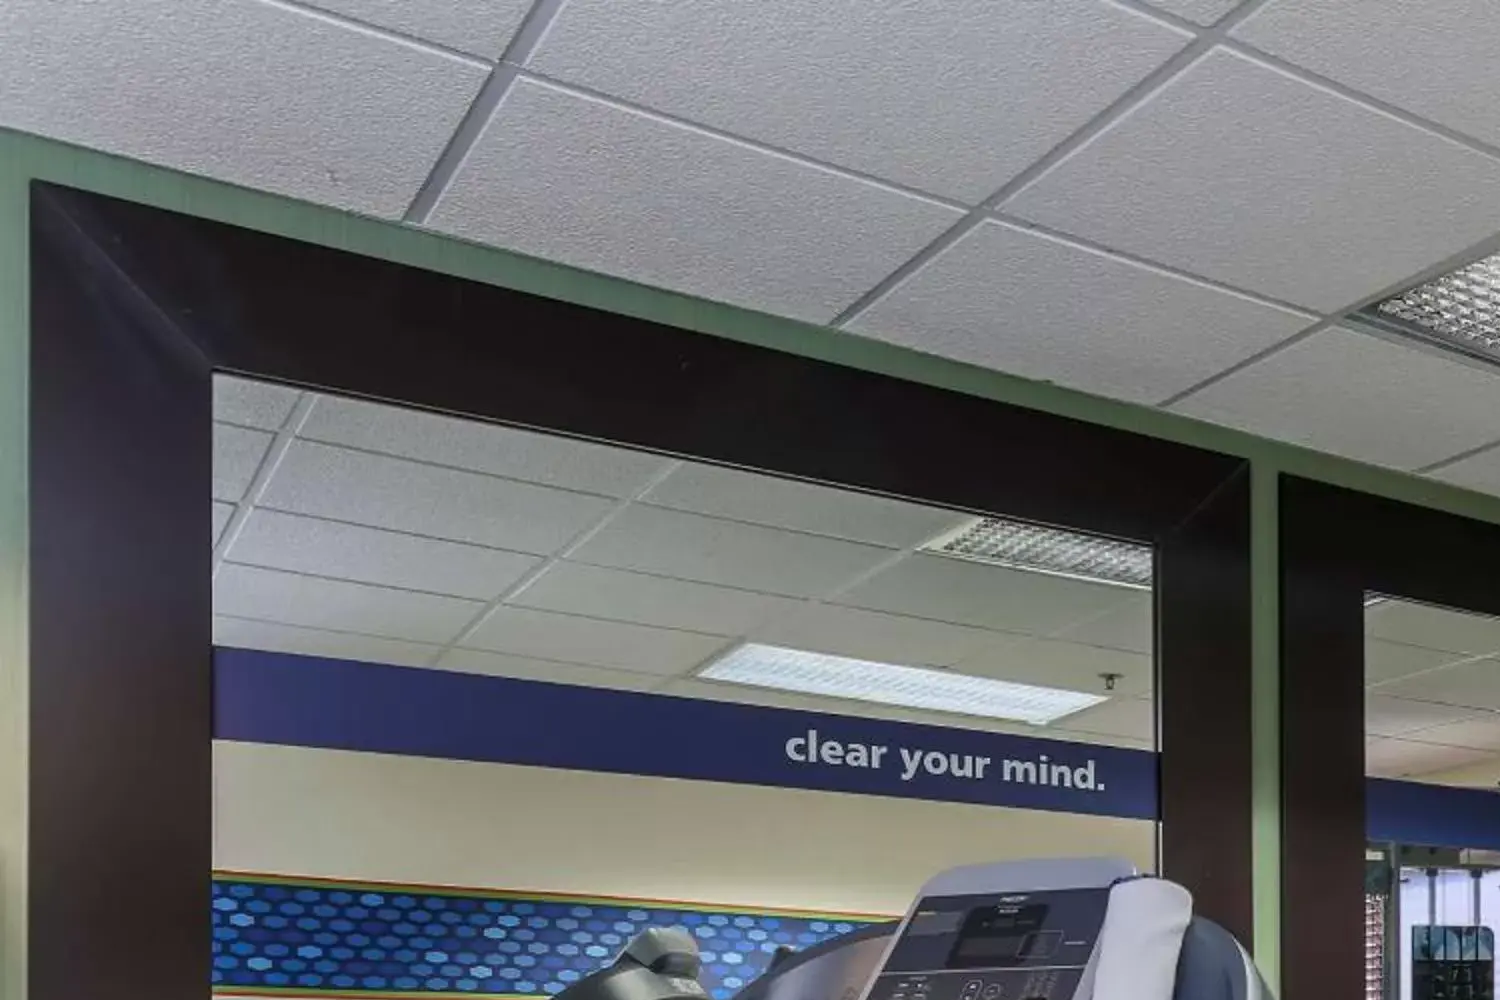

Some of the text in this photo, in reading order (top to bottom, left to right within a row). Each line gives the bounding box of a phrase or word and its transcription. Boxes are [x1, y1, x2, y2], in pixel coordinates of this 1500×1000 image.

[785, 729, 1105, 791] clear your mind.
